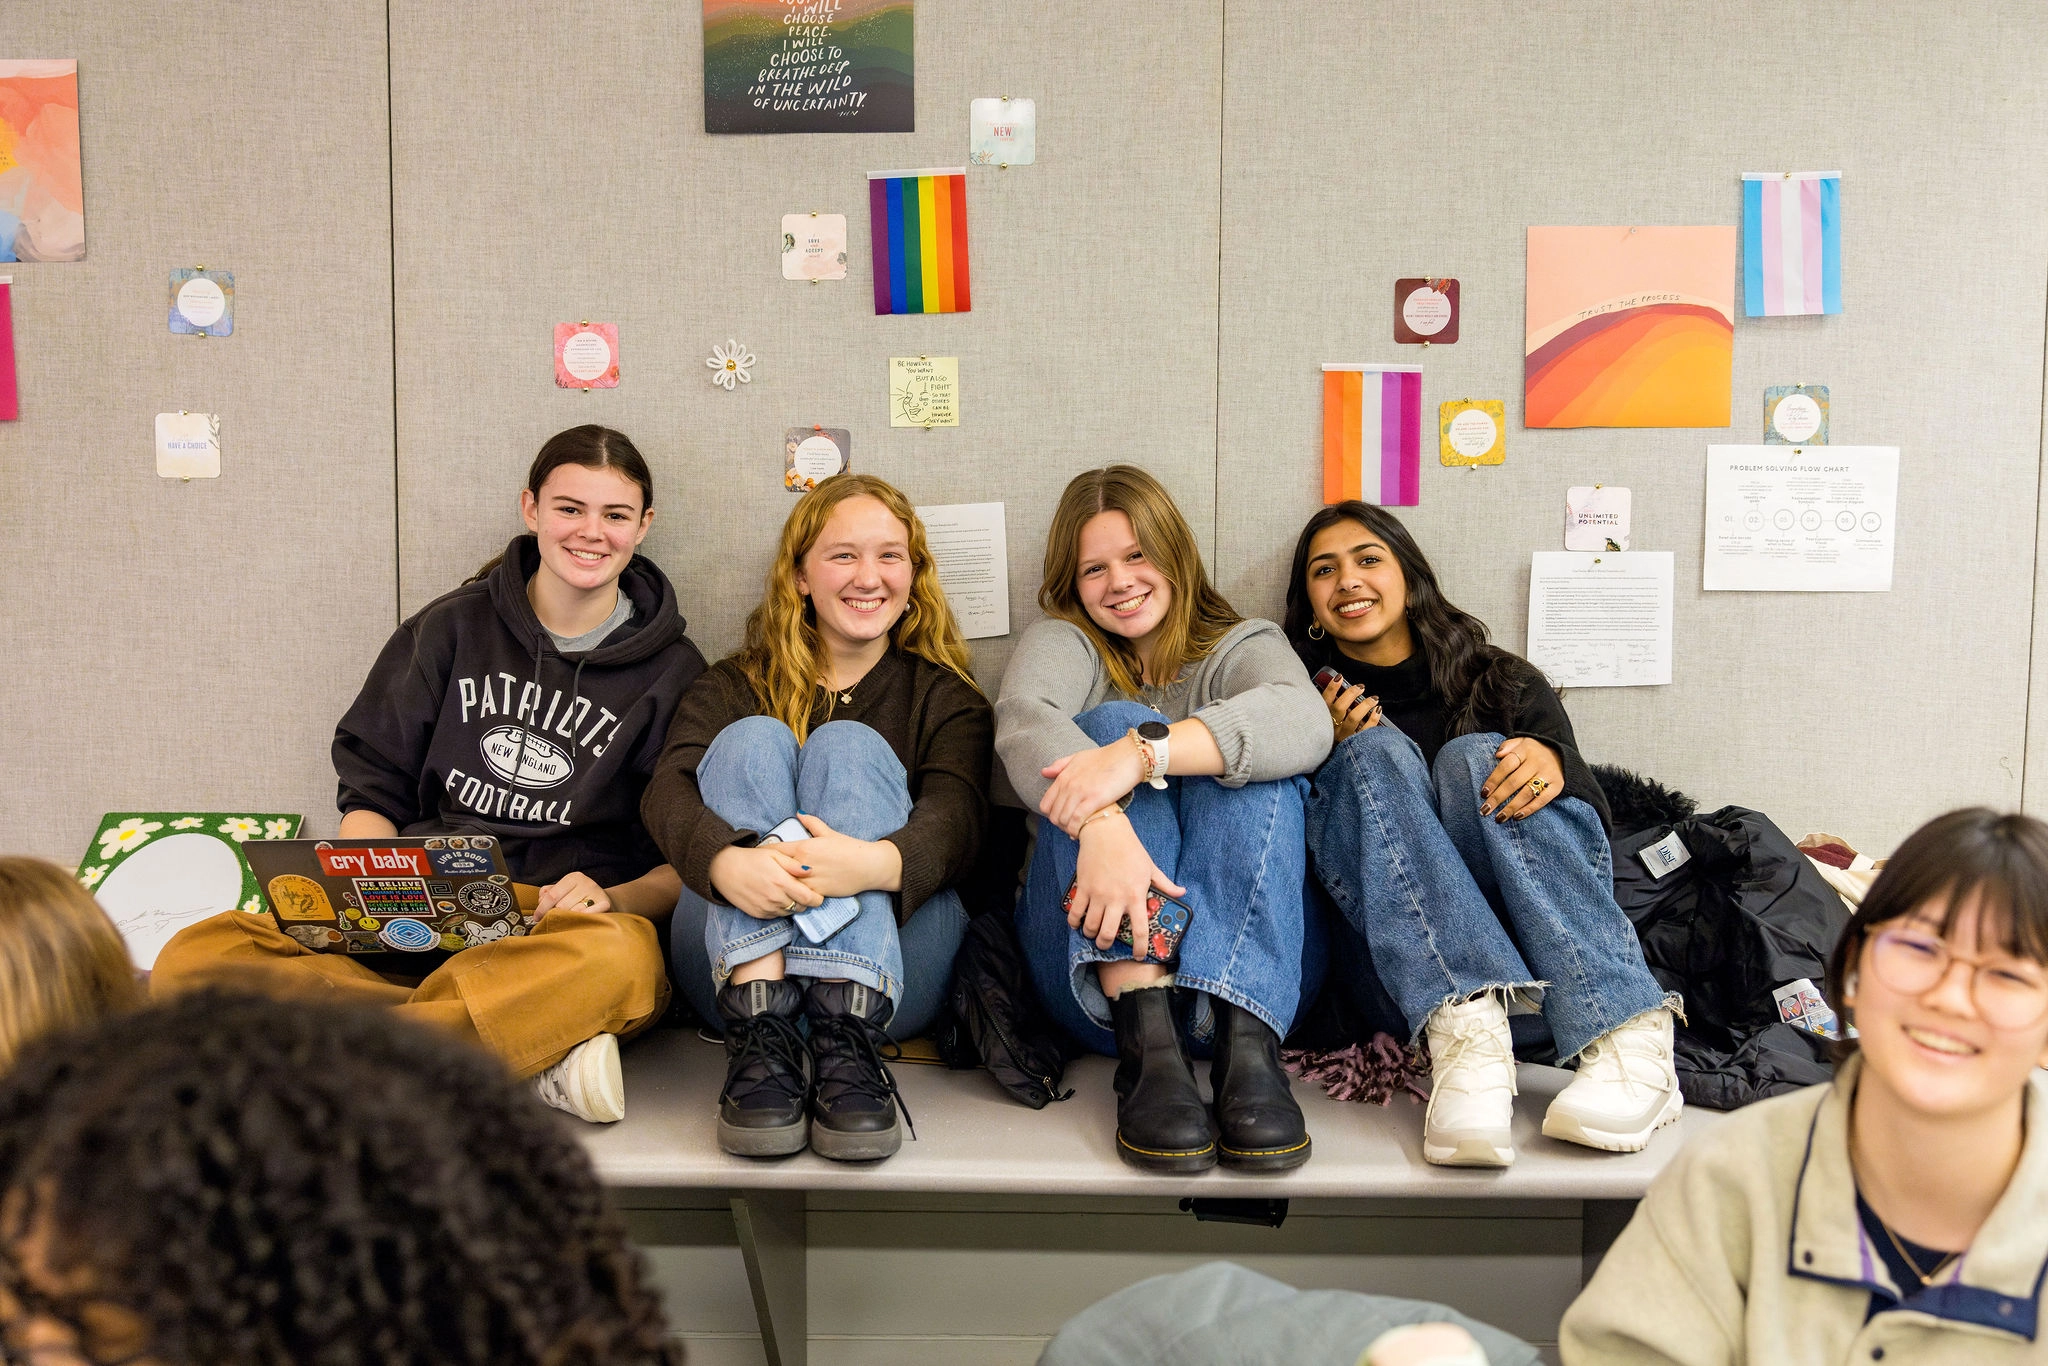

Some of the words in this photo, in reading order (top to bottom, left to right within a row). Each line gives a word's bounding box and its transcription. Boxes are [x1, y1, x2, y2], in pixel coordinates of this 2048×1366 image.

[792, 6, 796, 14] I
[804, 0, 842, 14] WILL
[783, 13, 834, 24] CHOOSE
[789, 26, 832, 38] PEACE.
[783, 40, 787, 51] I
[792, 38, 824, 49] WILL
[770, 48, 825, 67] CHOOSE
[828, 46, 842, 60] TO
[758, 66, 817, 82] BREATHE
[819, 60, 850, 75] DEEP
[748, 84, 766, 95] IN
[772, 82, 804, 97] THE
[808, 75, 852, 96] WILD
[753, 98, 771, 110] OF
[773, 91, 868, 111] UNCERTAINTY.
[994, 127, 1012, 136] NEW
[1578, 304, 1612, 320] TRUST
[1620, 298, 1636, 309] THE
[1642, 294, 1680, 302] PROCESS
[458, 672, 622, 758] PATRIOTS
[490, 742, 512, 758] NEW
[446, 768, 572, 826] FOOTBALL
[330, 856, 368, 876] cry
[368, 848, 420, 876] baby
[464, 852, 487, 863] GOOD
